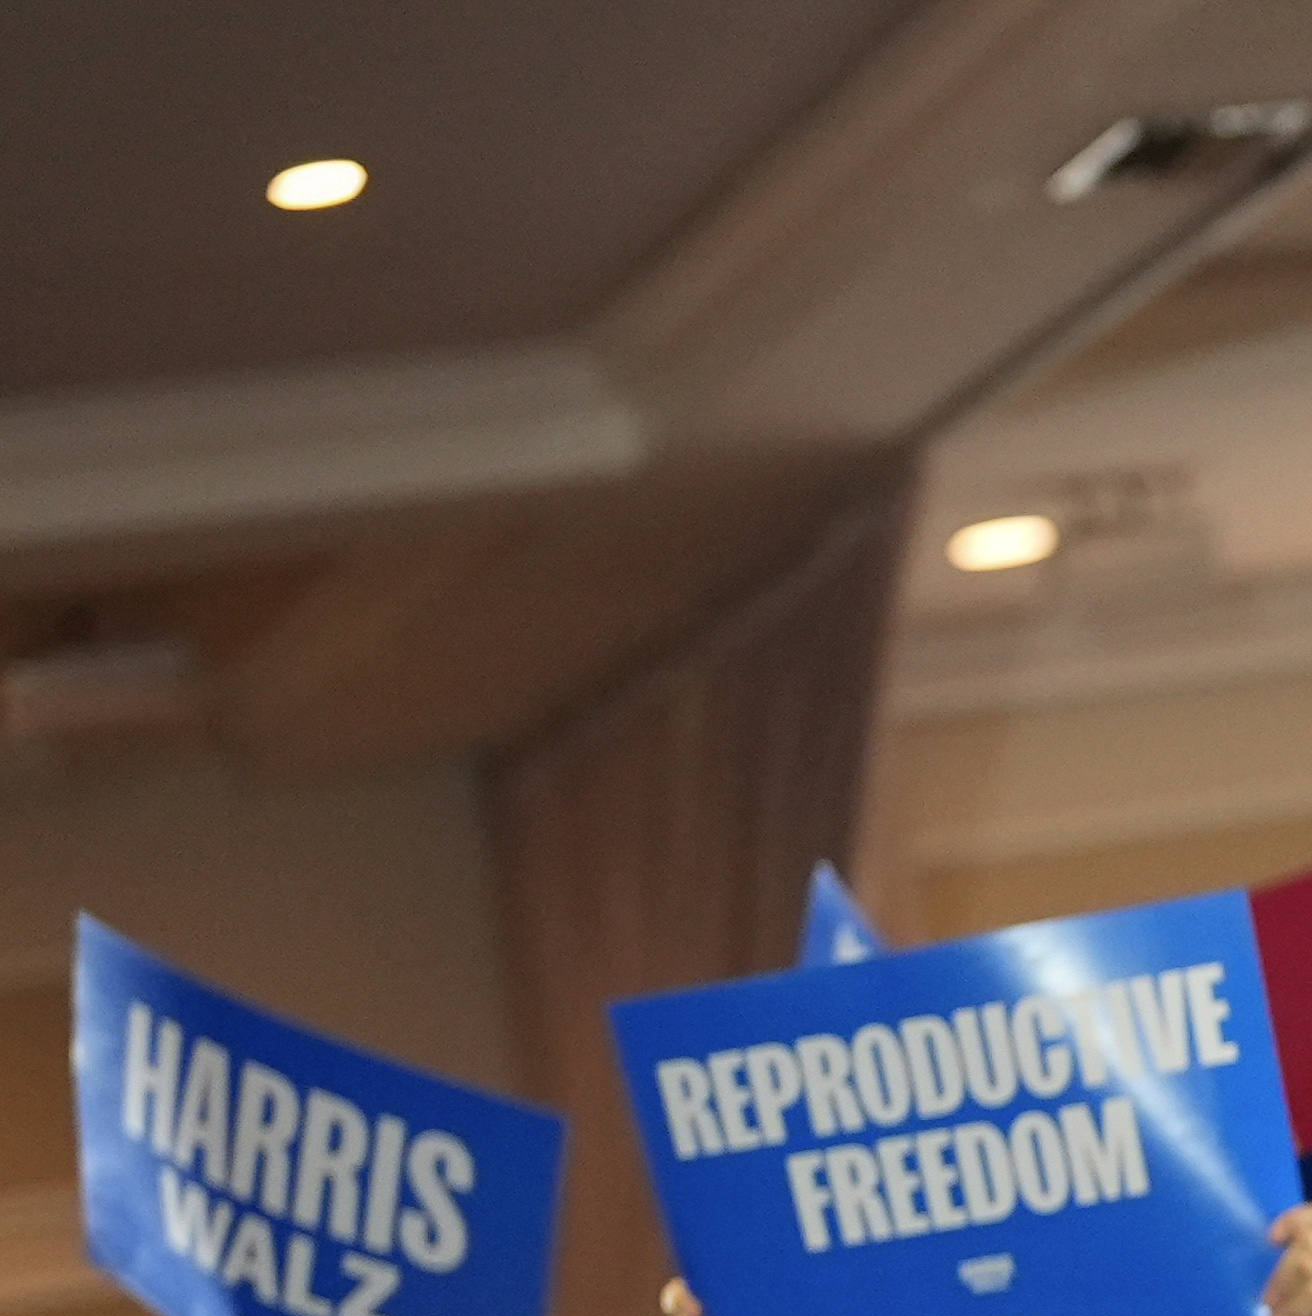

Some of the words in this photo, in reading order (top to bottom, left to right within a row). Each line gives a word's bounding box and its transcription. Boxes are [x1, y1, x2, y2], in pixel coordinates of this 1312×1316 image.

[123, 1000, 476, 1274] HARRIS
[655, 961, 1241, 1162] REPRODUCTIVE
[786, 1096, 1150, 1253] FREEDOM
